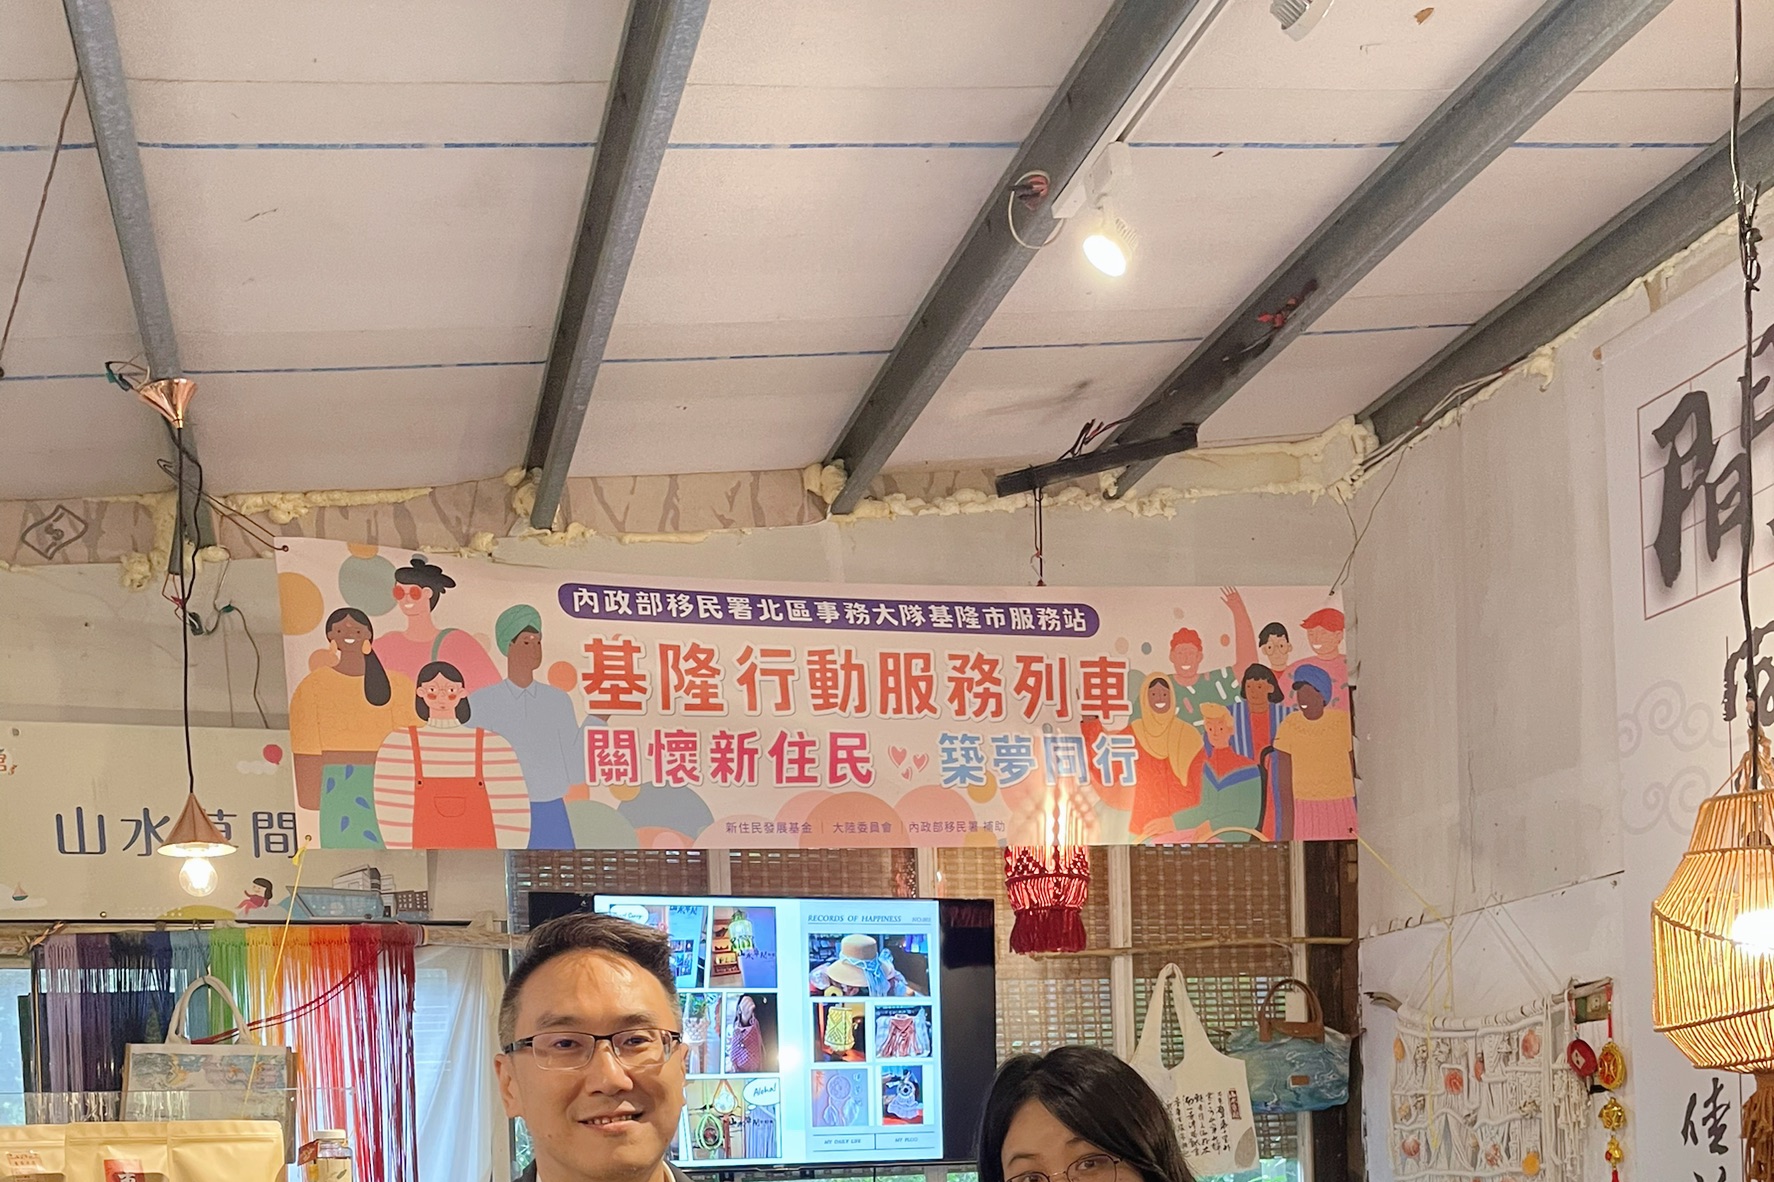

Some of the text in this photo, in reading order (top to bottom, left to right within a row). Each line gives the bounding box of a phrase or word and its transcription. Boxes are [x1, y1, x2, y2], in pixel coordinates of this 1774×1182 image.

[573, 587, 1087, 632] 內政部移民署北區事務大隊基隆市服務站
[581, 637, 1133, 720] 基隆行動服務列車
[585, 729, 1139, 787] 關懷新住民 築夢同行
[725, 820, 1006, 834] 新住民發展基金 大陸委員會 內政部移民署 補助
[808, 914, 844, 922] RECORDS
[847, 914, 859, 922] OF
[861, 915, 902, 923] HAPPINESS
[753, 1083, 777, 1097] Aloha!
